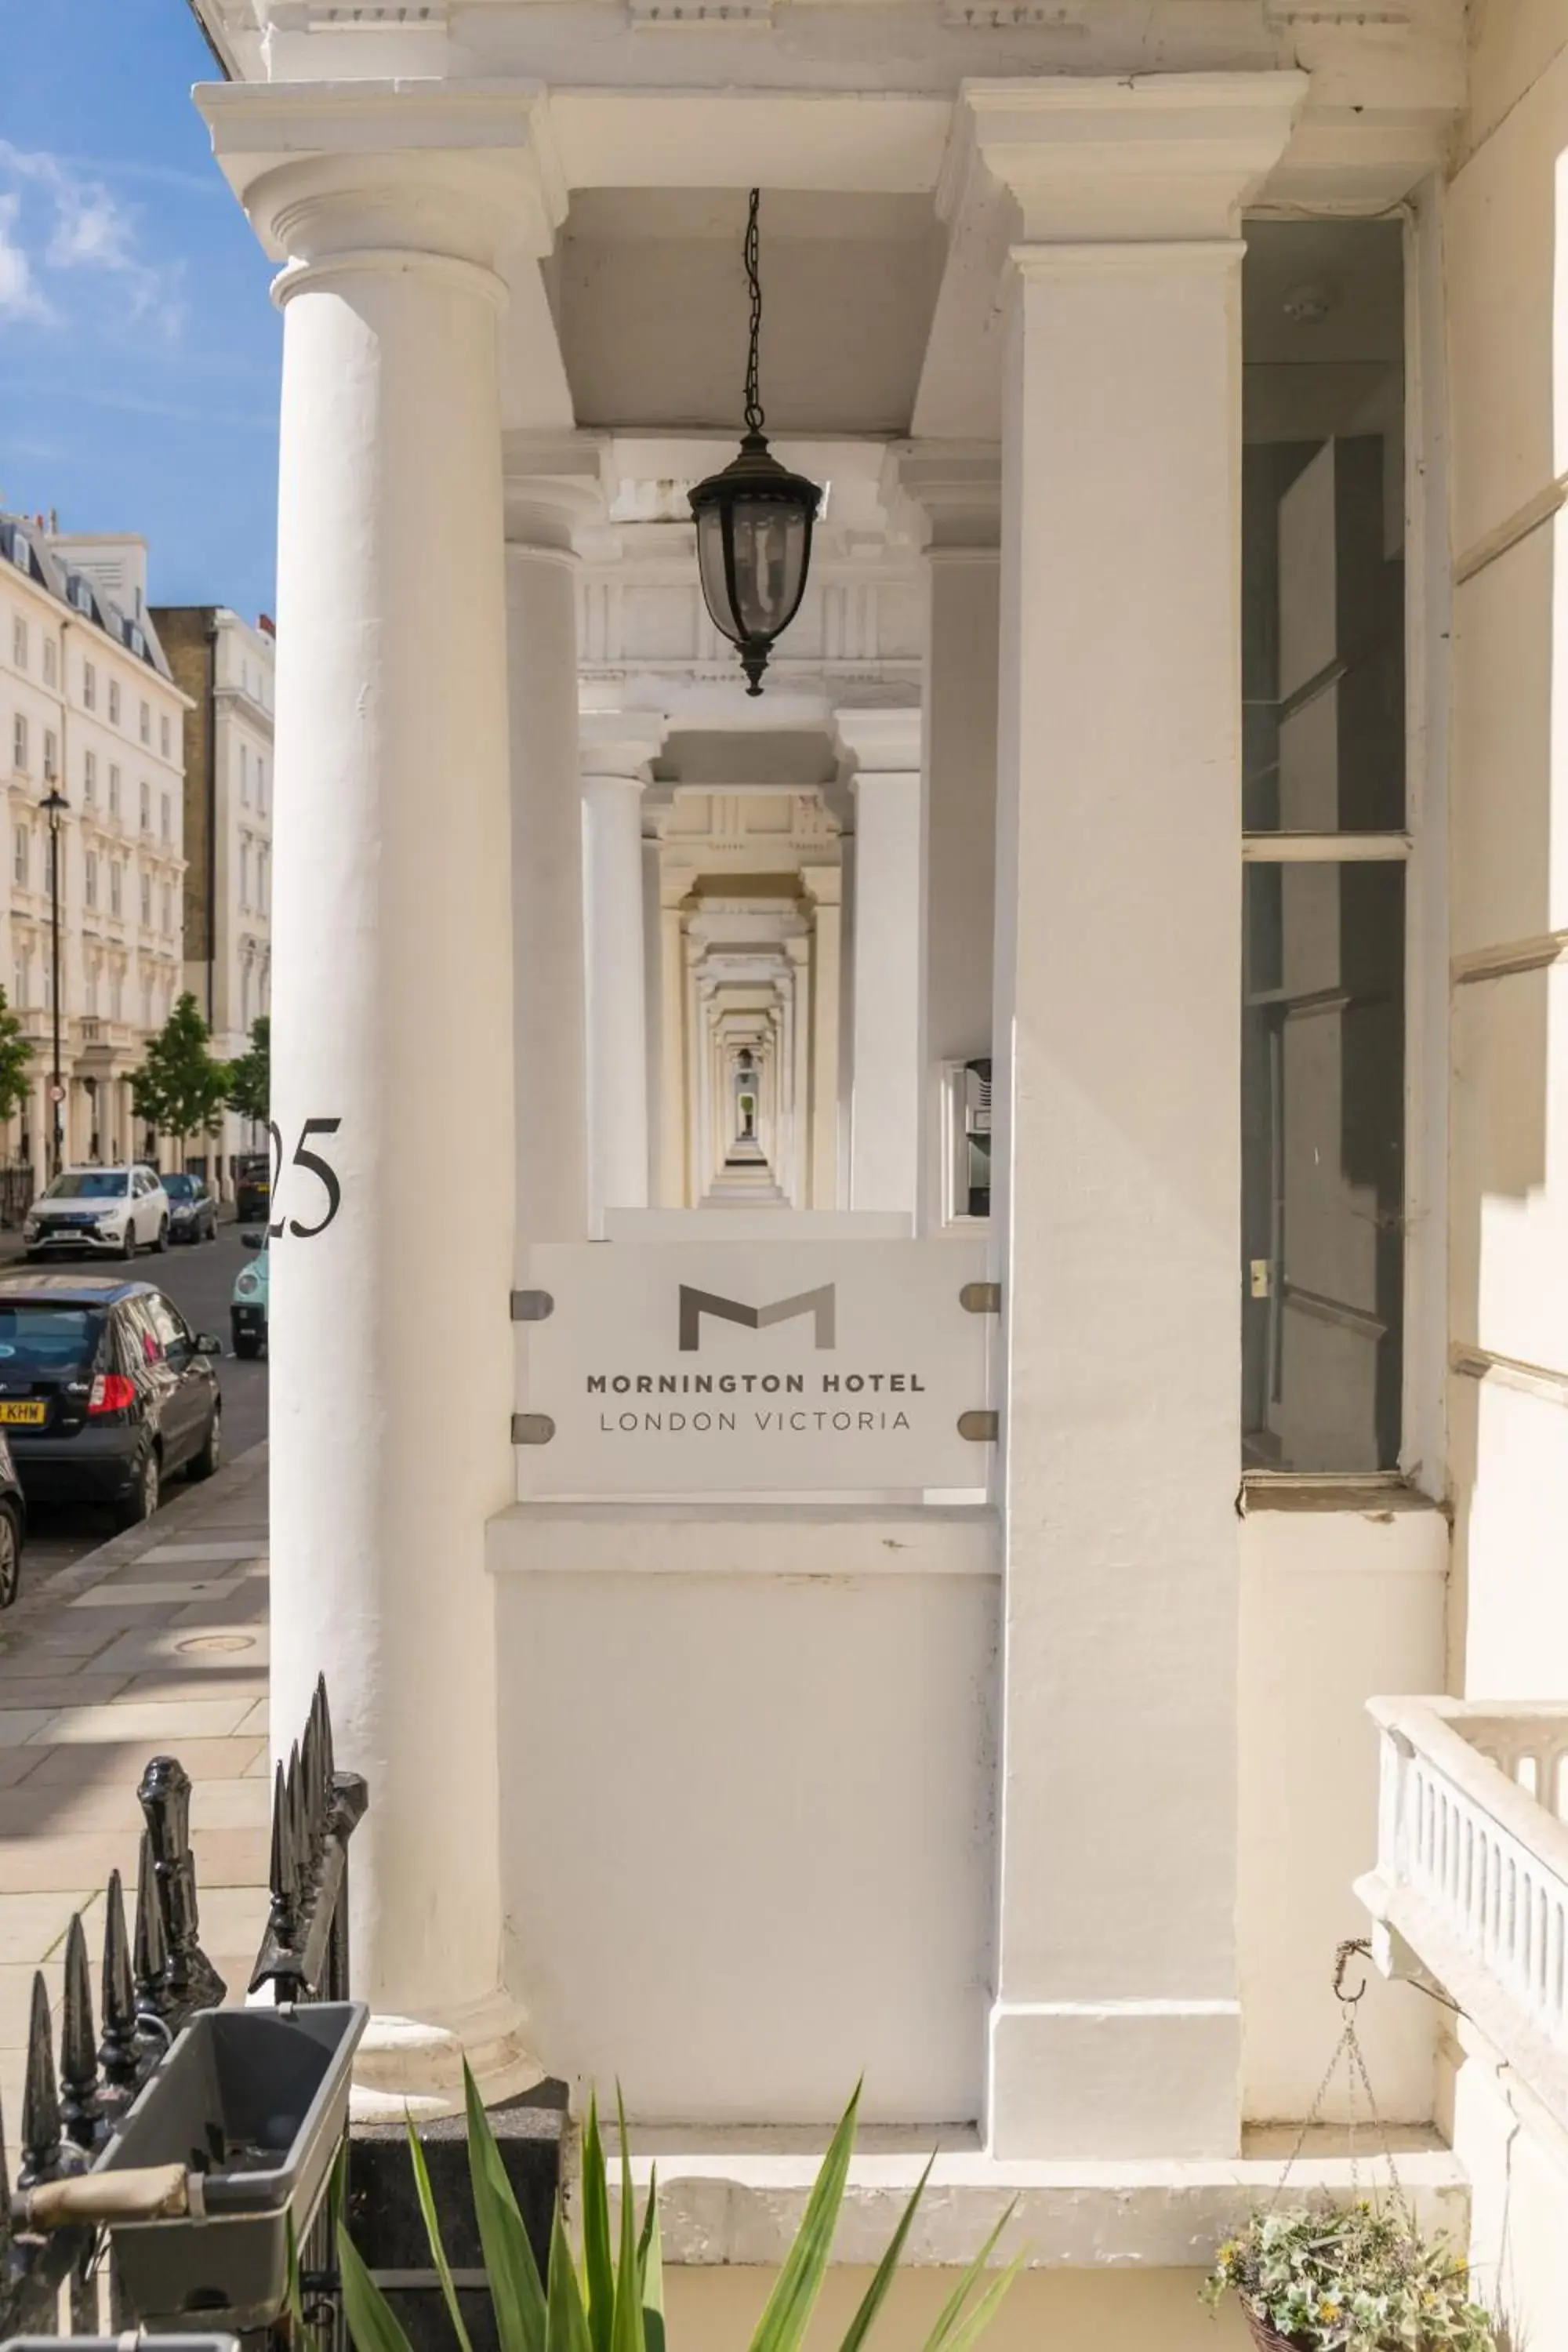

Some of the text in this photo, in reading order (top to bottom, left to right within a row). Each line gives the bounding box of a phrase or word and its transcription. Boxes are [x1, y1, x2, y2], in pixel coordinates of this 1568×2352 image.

[586, 1373, 926, 1394] MORNINGTON HOTEL
[600, 1411, 910, 1432] LONDON VICTORIA
